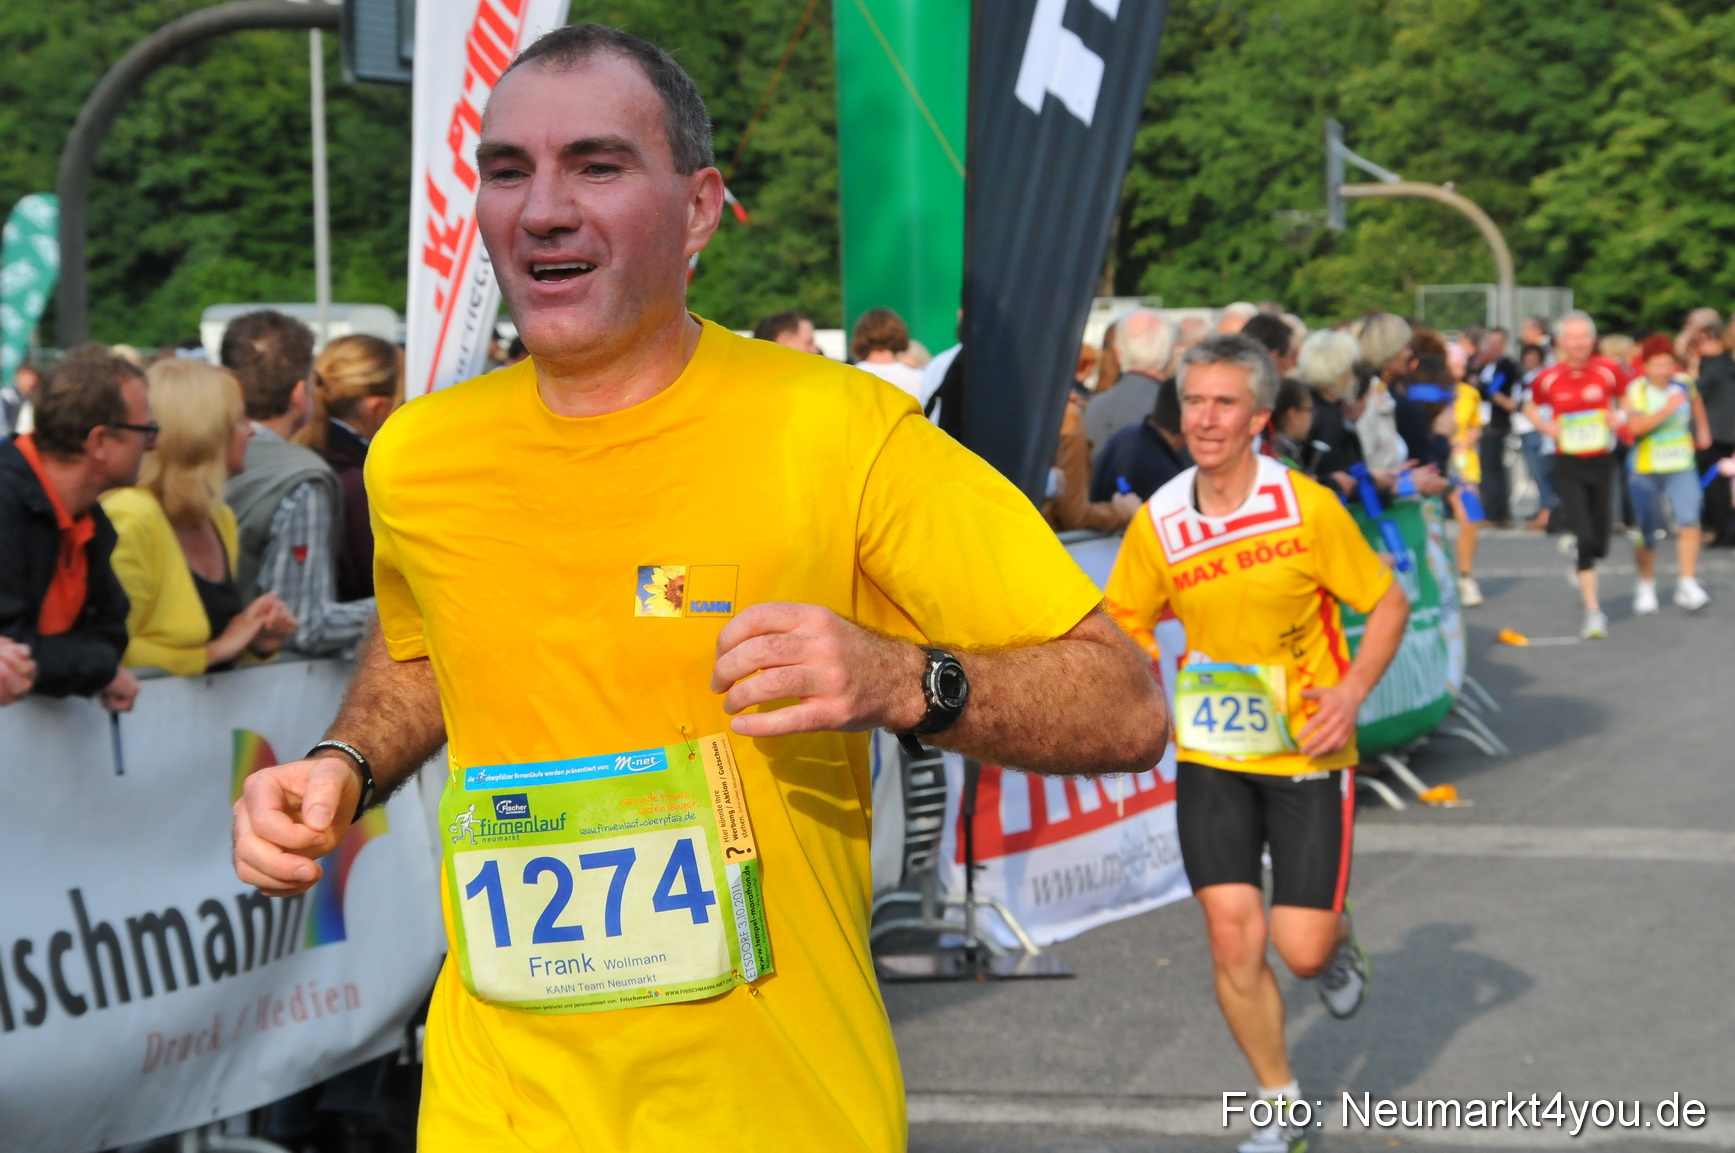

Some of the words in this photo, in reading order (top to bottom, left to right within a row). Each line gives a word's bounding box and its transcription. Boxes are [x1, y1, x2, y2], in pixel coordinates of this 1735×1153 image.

[1172, 558, 1229, 593] MAX
[1236, 537, 1310, 571] BÖGL
[690, 601, 731, 613] KANN
[1193, 696, 1269, 733] 425
[712, 741, 724, 776] Gutschein
[514, 769, 544, 780] firmenläufe
[544, 767, 564, 777] werden
[565, 763, 597, 775] präsentiert
[597, 763, 609, 772] von:
[620, 793, 658, 807] Gesunde
[660, 791, 690, 803] Firmen
[722, 781, 732, 804] Aktion
[502, 804, 527, 812] Fischer
[667, 798, 701, 813] länger!
[718, 804, 727, 828] könnte
[480, 812, 567, 836] firmenlauf
[579, 811, 696, 836] www.firmenlauf-oberpfalz.de
[728, 809, 739, 841] Werbung
[738, 814, 748, 839] stehen.
[482, 834, 520, 843] neumarkt
[720, 829, 730, 844] Hier
[465, 838, 716, 948] 1274
[732, 884, 748, 929] 3.10.2011
[742, 865, 765, 972] www.tempel-marathon.de
[529, 953, 596, 978] Frank
[604, 953, 667, 970] Wollmann
[739, 931, 757, 979] ETSDORF
[546, 984, 576, 995] KANN
[578, 981, 605, 992] Team
[608, 973, 657, 988] Neumarkt
[664, 977, 733, 997] WWW.FRISCHMANN-NET.DE
[542, 1003, 563, 1011] gedruckt
[573, 1000, 606, 1009] personalisiert
[141, 1012, 222, 1074] Druck
[255, 980, 362, 1033] Medien
